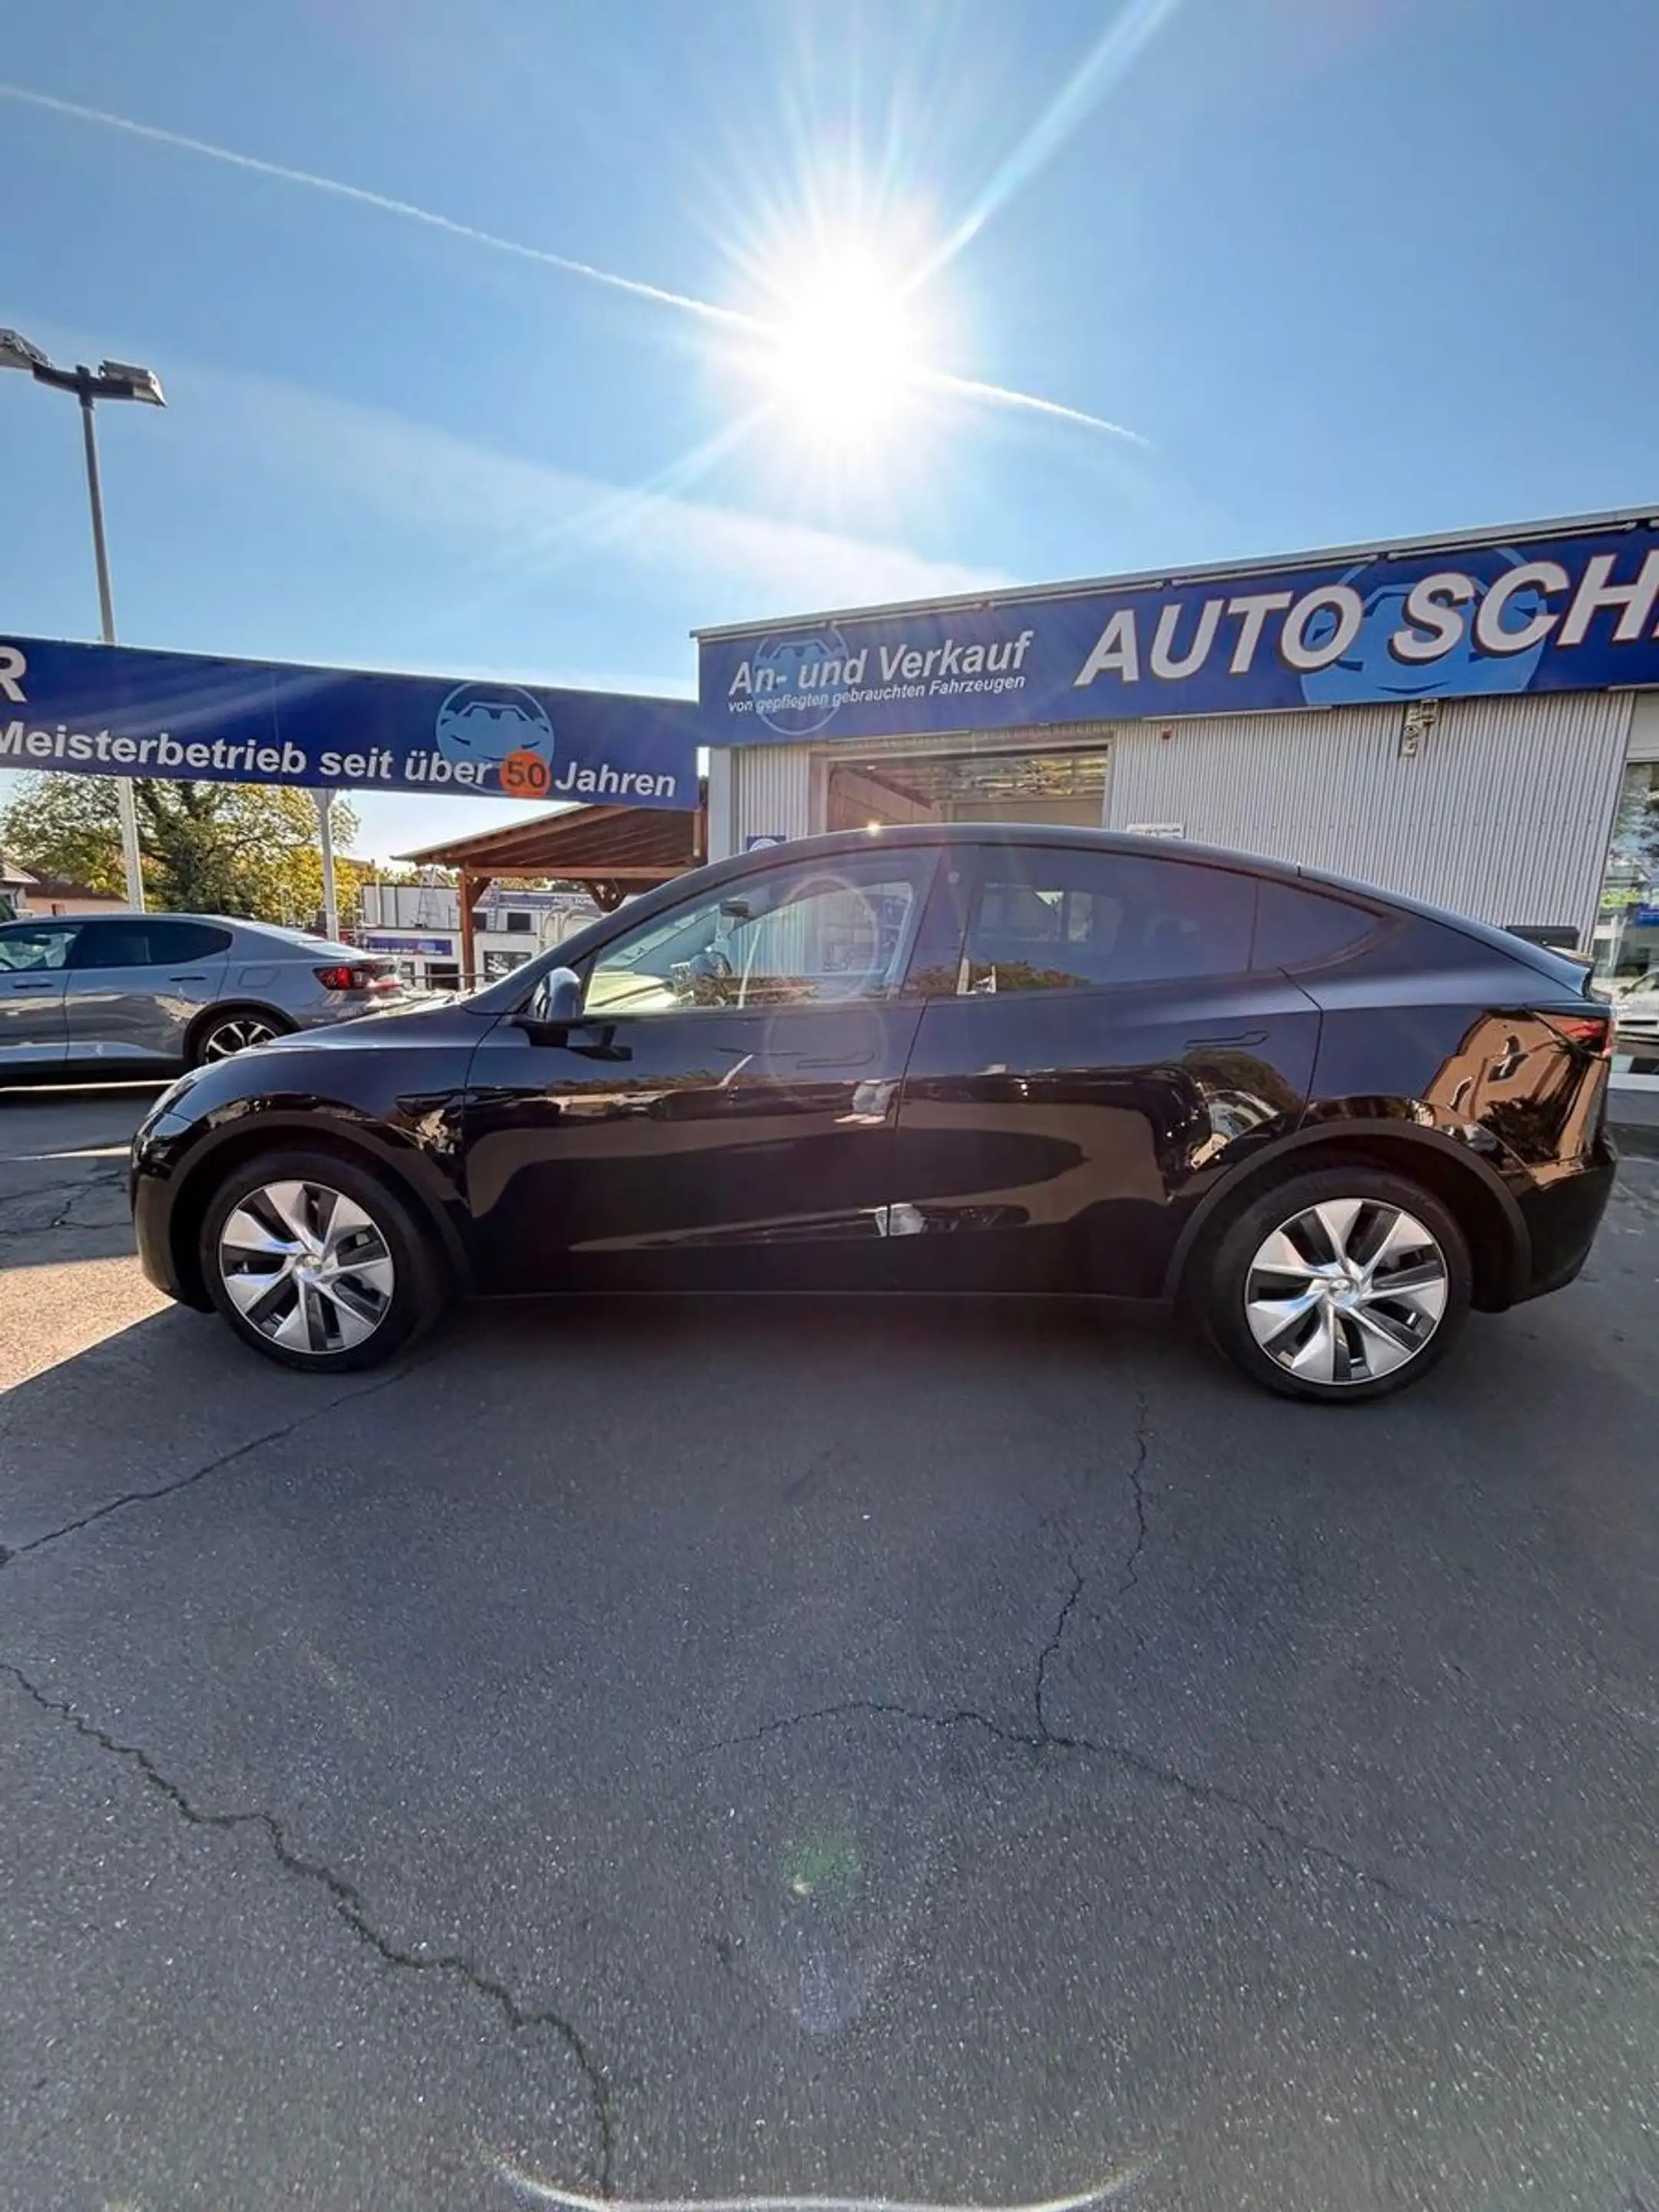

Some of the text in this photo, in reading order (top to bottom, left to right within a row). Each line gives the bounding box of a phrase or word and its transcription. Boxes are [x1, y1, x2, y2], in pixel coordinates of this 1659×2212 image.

[1075, 548, 1659, 687] AUTO SCH
[729, 631, 1034, 696] An- und Verkauf
[729, 700, 753, 713] von
[832, 683, 925, 707] gebrauchten
[929, 674, 1026, 696] Fahrzeugen
[0, 721, 677, 798] Meisterbetrieb seit über 50 Jahren
